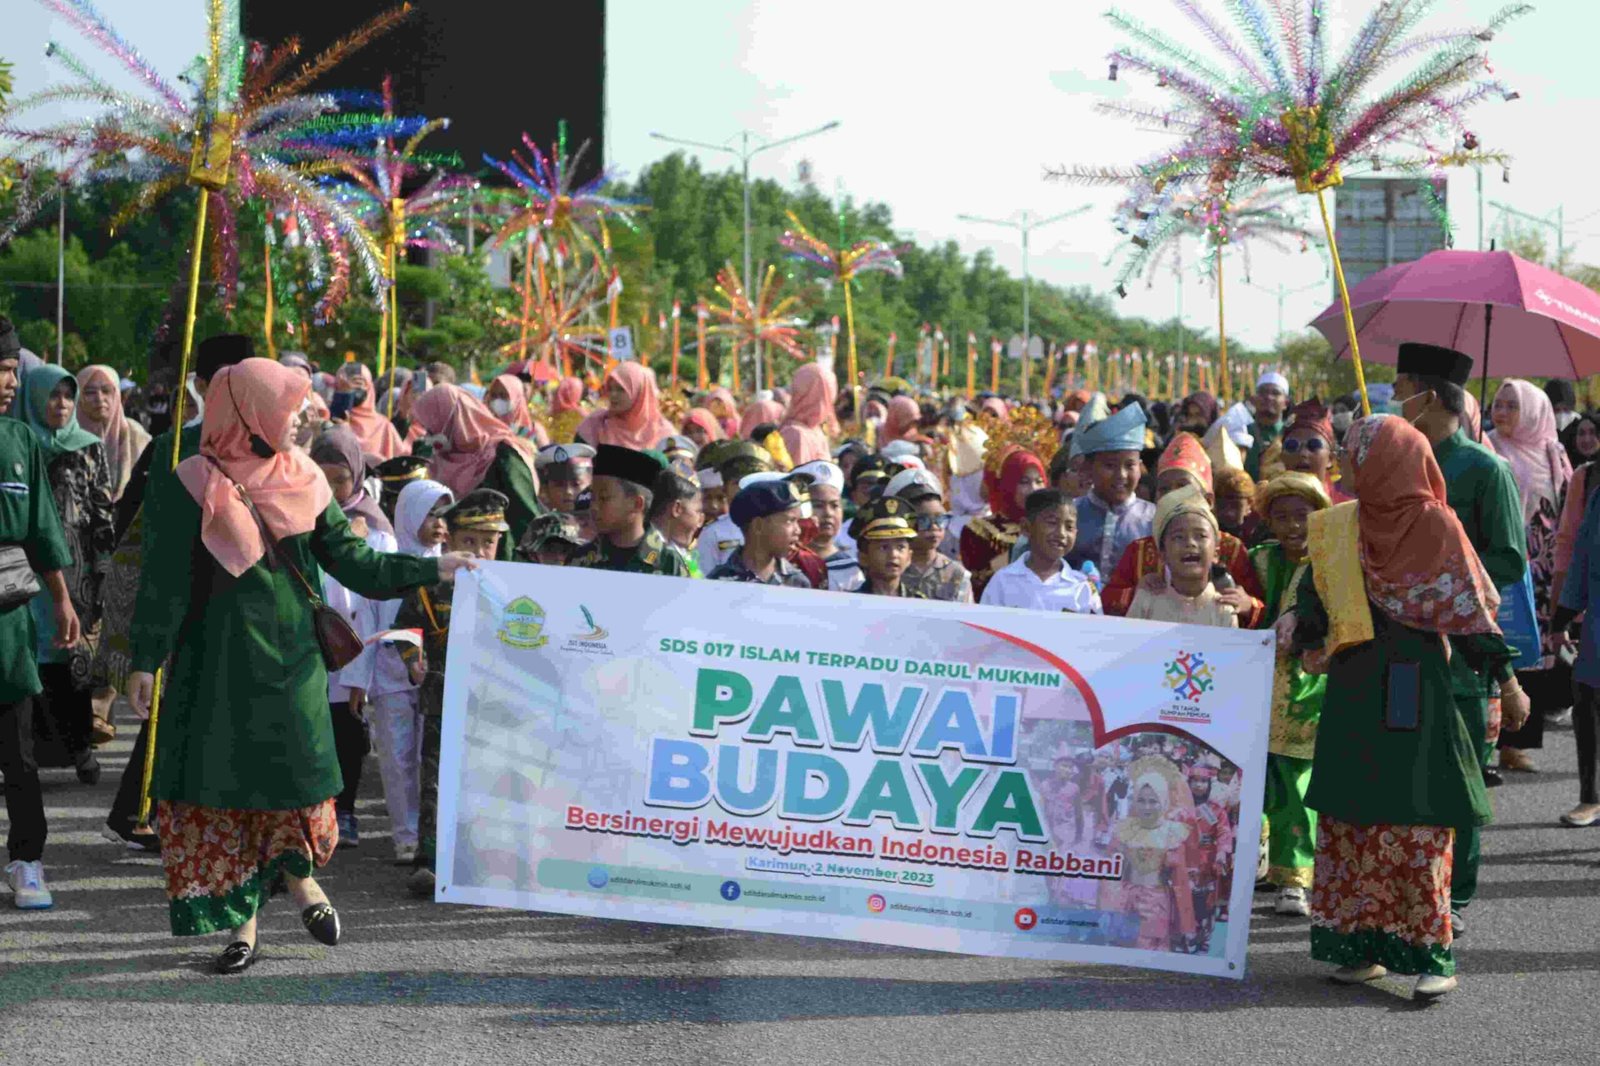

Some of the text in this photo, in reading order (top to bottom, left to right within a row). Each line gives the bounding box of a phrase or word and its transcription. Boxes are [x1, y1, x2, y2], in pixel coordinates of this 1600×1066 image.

[614, 334, 627, 349] 8
[659, 638, 1061, 687] SDS 017 ISLAM TERPADU DARUL MUKMIN
[691, 667, 1018, 759] PAWAI
[647, 737, 1046, 838] BUDAYA
[566, 805, 1122, 876] Bersinergi Mewujudkan Indonesia Rabbani
[749, 856, 935, 884] Karimun, 2 November 2023
